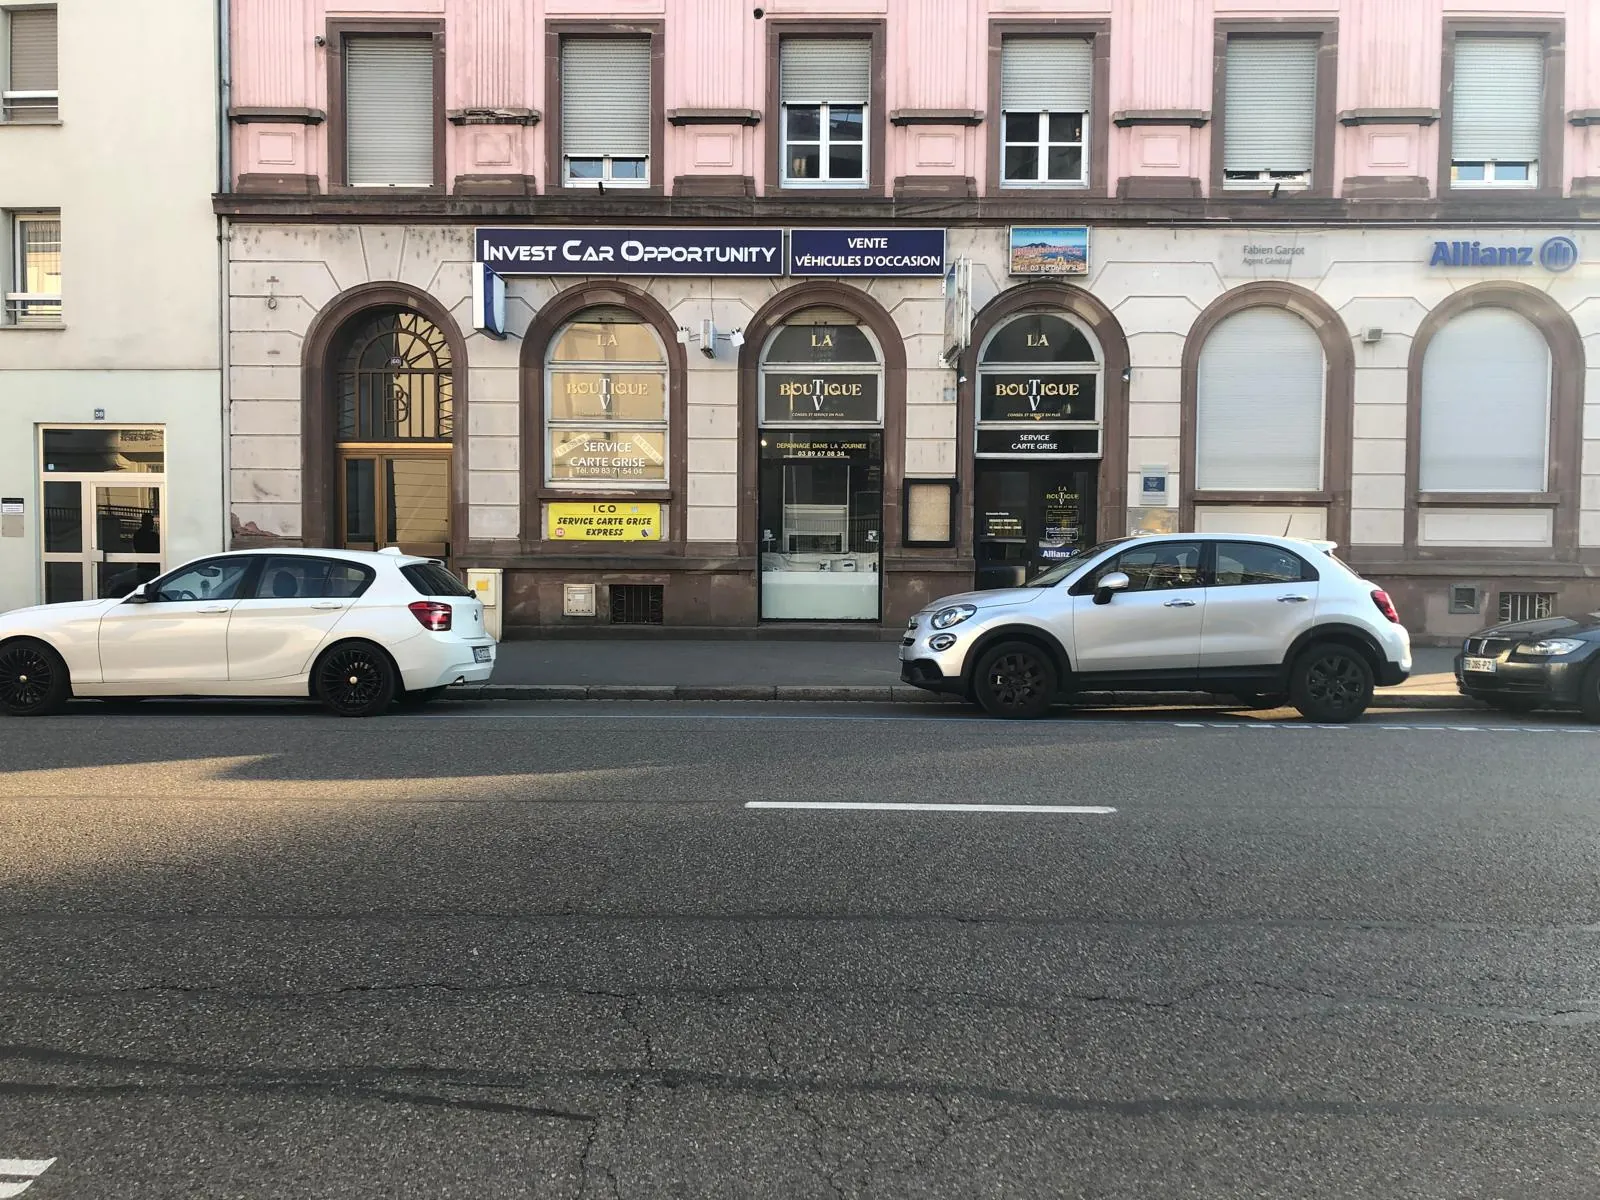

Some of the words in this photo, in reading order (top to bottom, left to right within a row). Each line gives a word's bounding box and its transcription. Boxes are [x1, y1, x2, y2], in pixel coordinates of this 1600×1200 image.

[847, 237, 888, 249] VENTE
[483, 239, 557, 262] INVEST
[562, 240, 614, 262] CAR
[620, 240, 777, 263] OPPORTUNITY
[1243, 244, 1273, 255] Fabien
[1429, 241, 1533, 268] Allianz
[795, 253, 861, 267] VÉHICULES
[864, 255, 940, 267] D'OCCASION
[1241, 257, 1264, 267] Agent
[596, 334, 618, 346] LA
[811, 334, 833, 347] LA
[1026, 334, 1049, 347] LA
[567, 378, 648, 395] BOUTIQUE
[780, 379, 862, 396] BOUTIQUE
[995, 379, 1080, 396] BOUTIQUE
[583, 442, 632, 452] SERVICE
[570, 456, 609, 467] CARTE
[611, 457, 646, 467] GRISE
[576, 467, 589, 475] Tél.
[590, 467, 600, 475] 09
[557, 517, 594, 525] SERVICE
[596, 517, 624, 525] CARTE
[626, 518, 652, 526] GRISE
[586, 528, 624, 537] EXPRESS
[1042, 549, 1071, 558] Allianz
